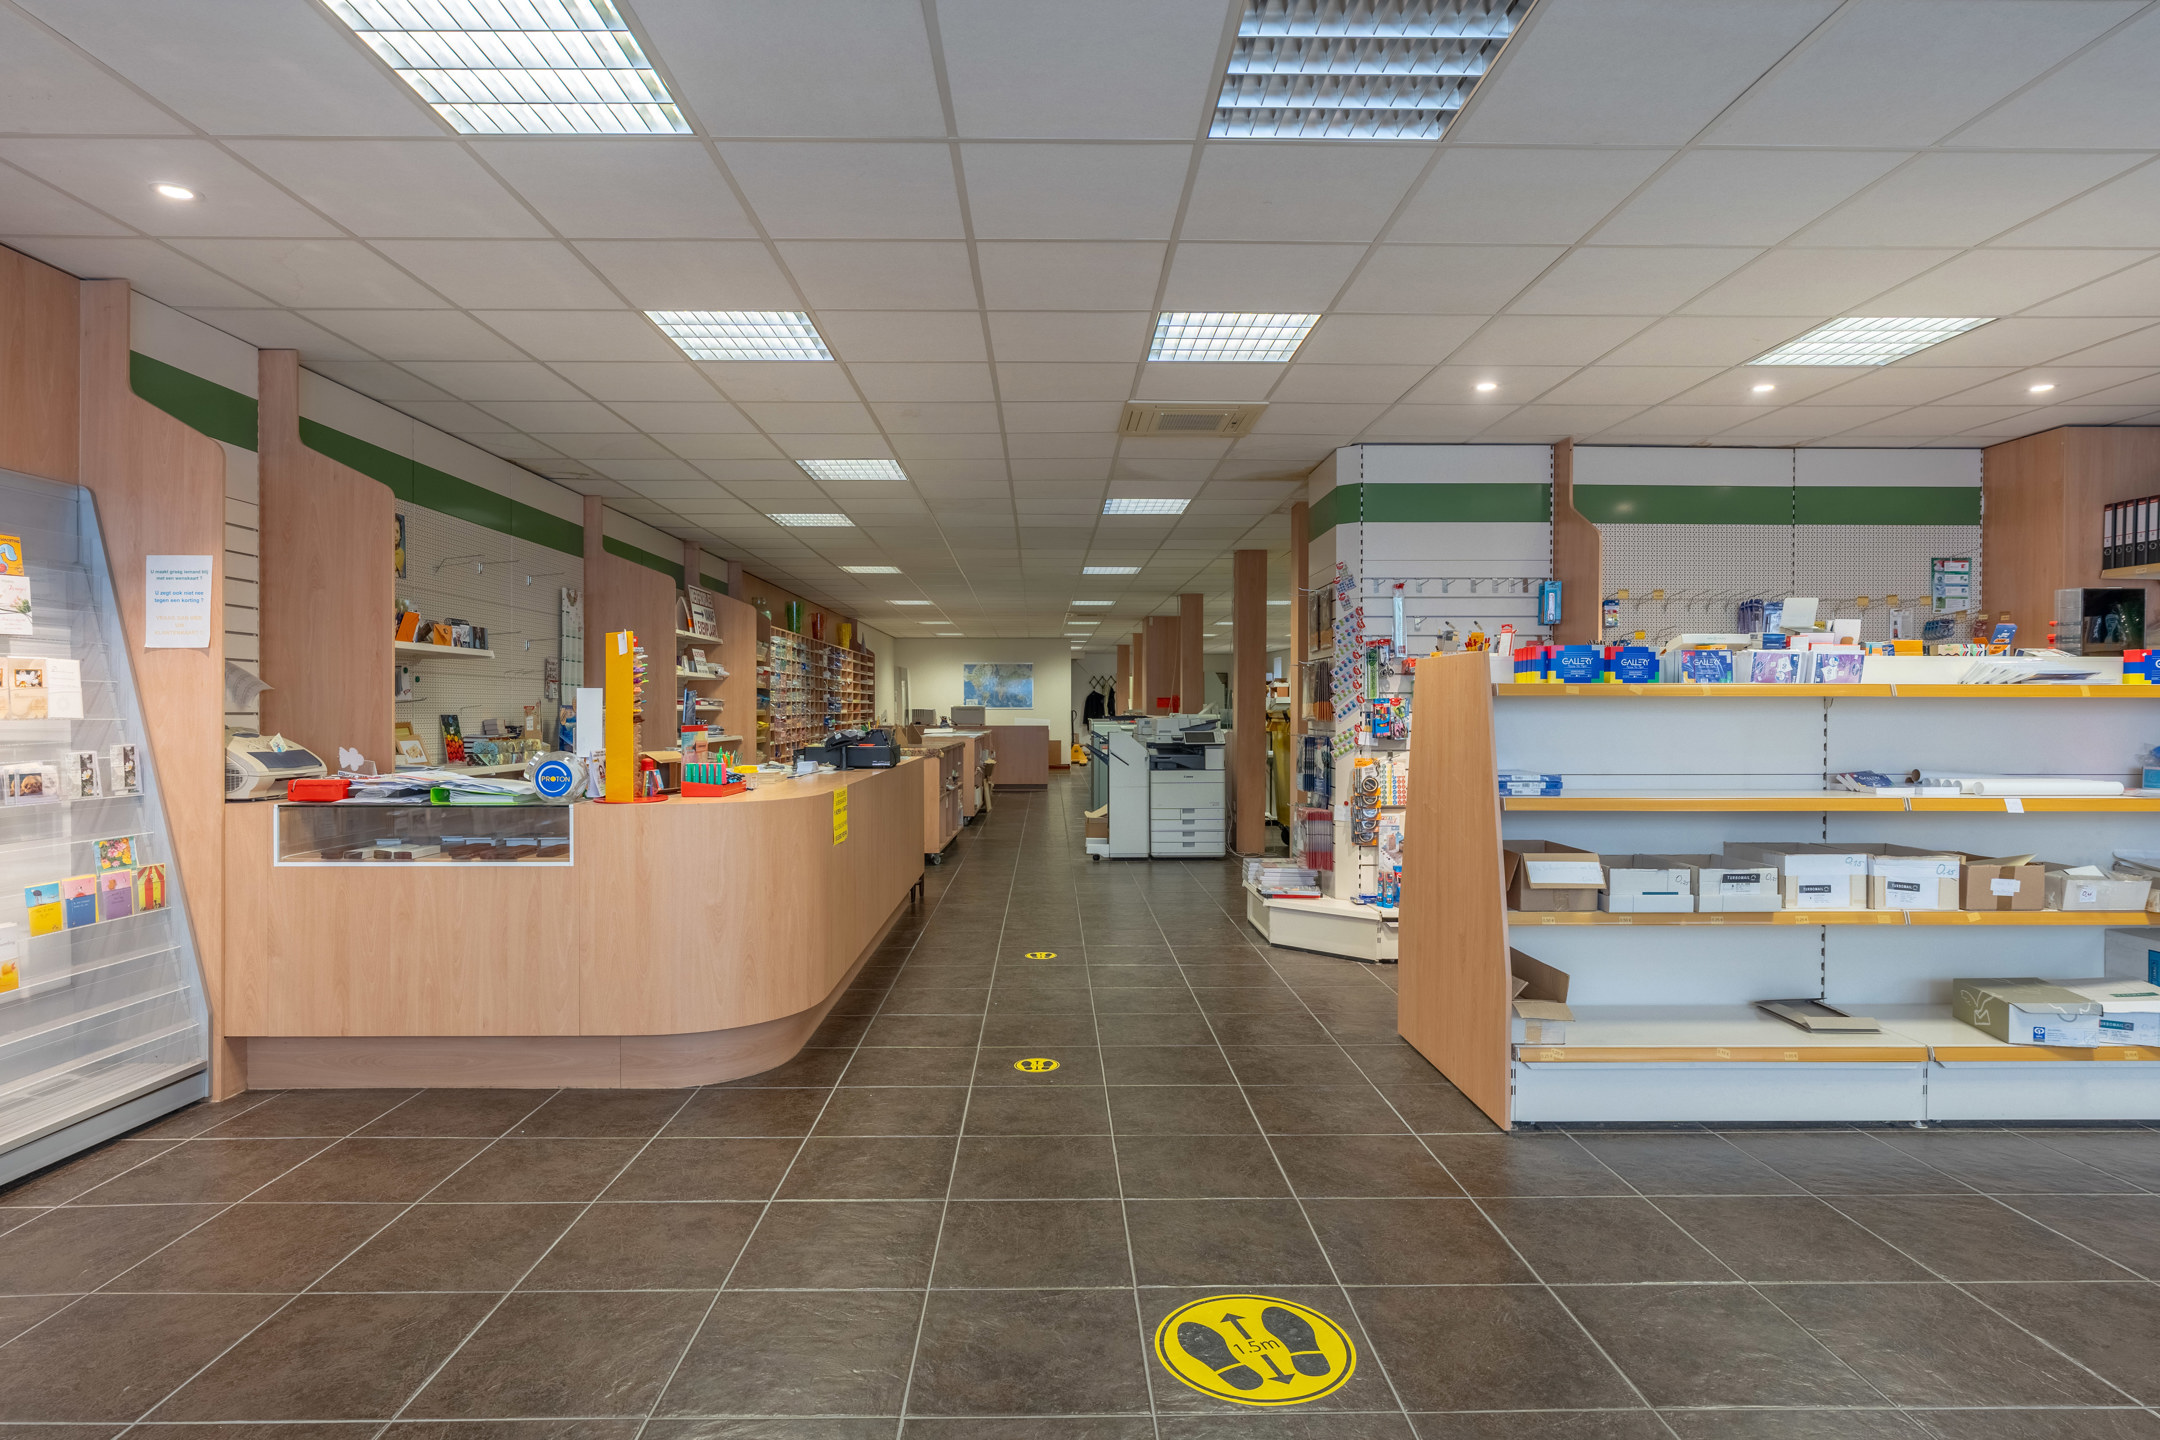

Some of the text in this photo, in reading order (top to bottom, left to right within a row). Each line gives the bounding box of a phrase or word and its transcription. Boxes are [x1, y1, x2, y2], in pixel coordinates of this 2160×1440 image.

[1562, 657, 1594, 665] GALLERY
[1620, 658, 1650, 666] GALLERY
[1233, 1339, 1280, 1354] 1.5m
